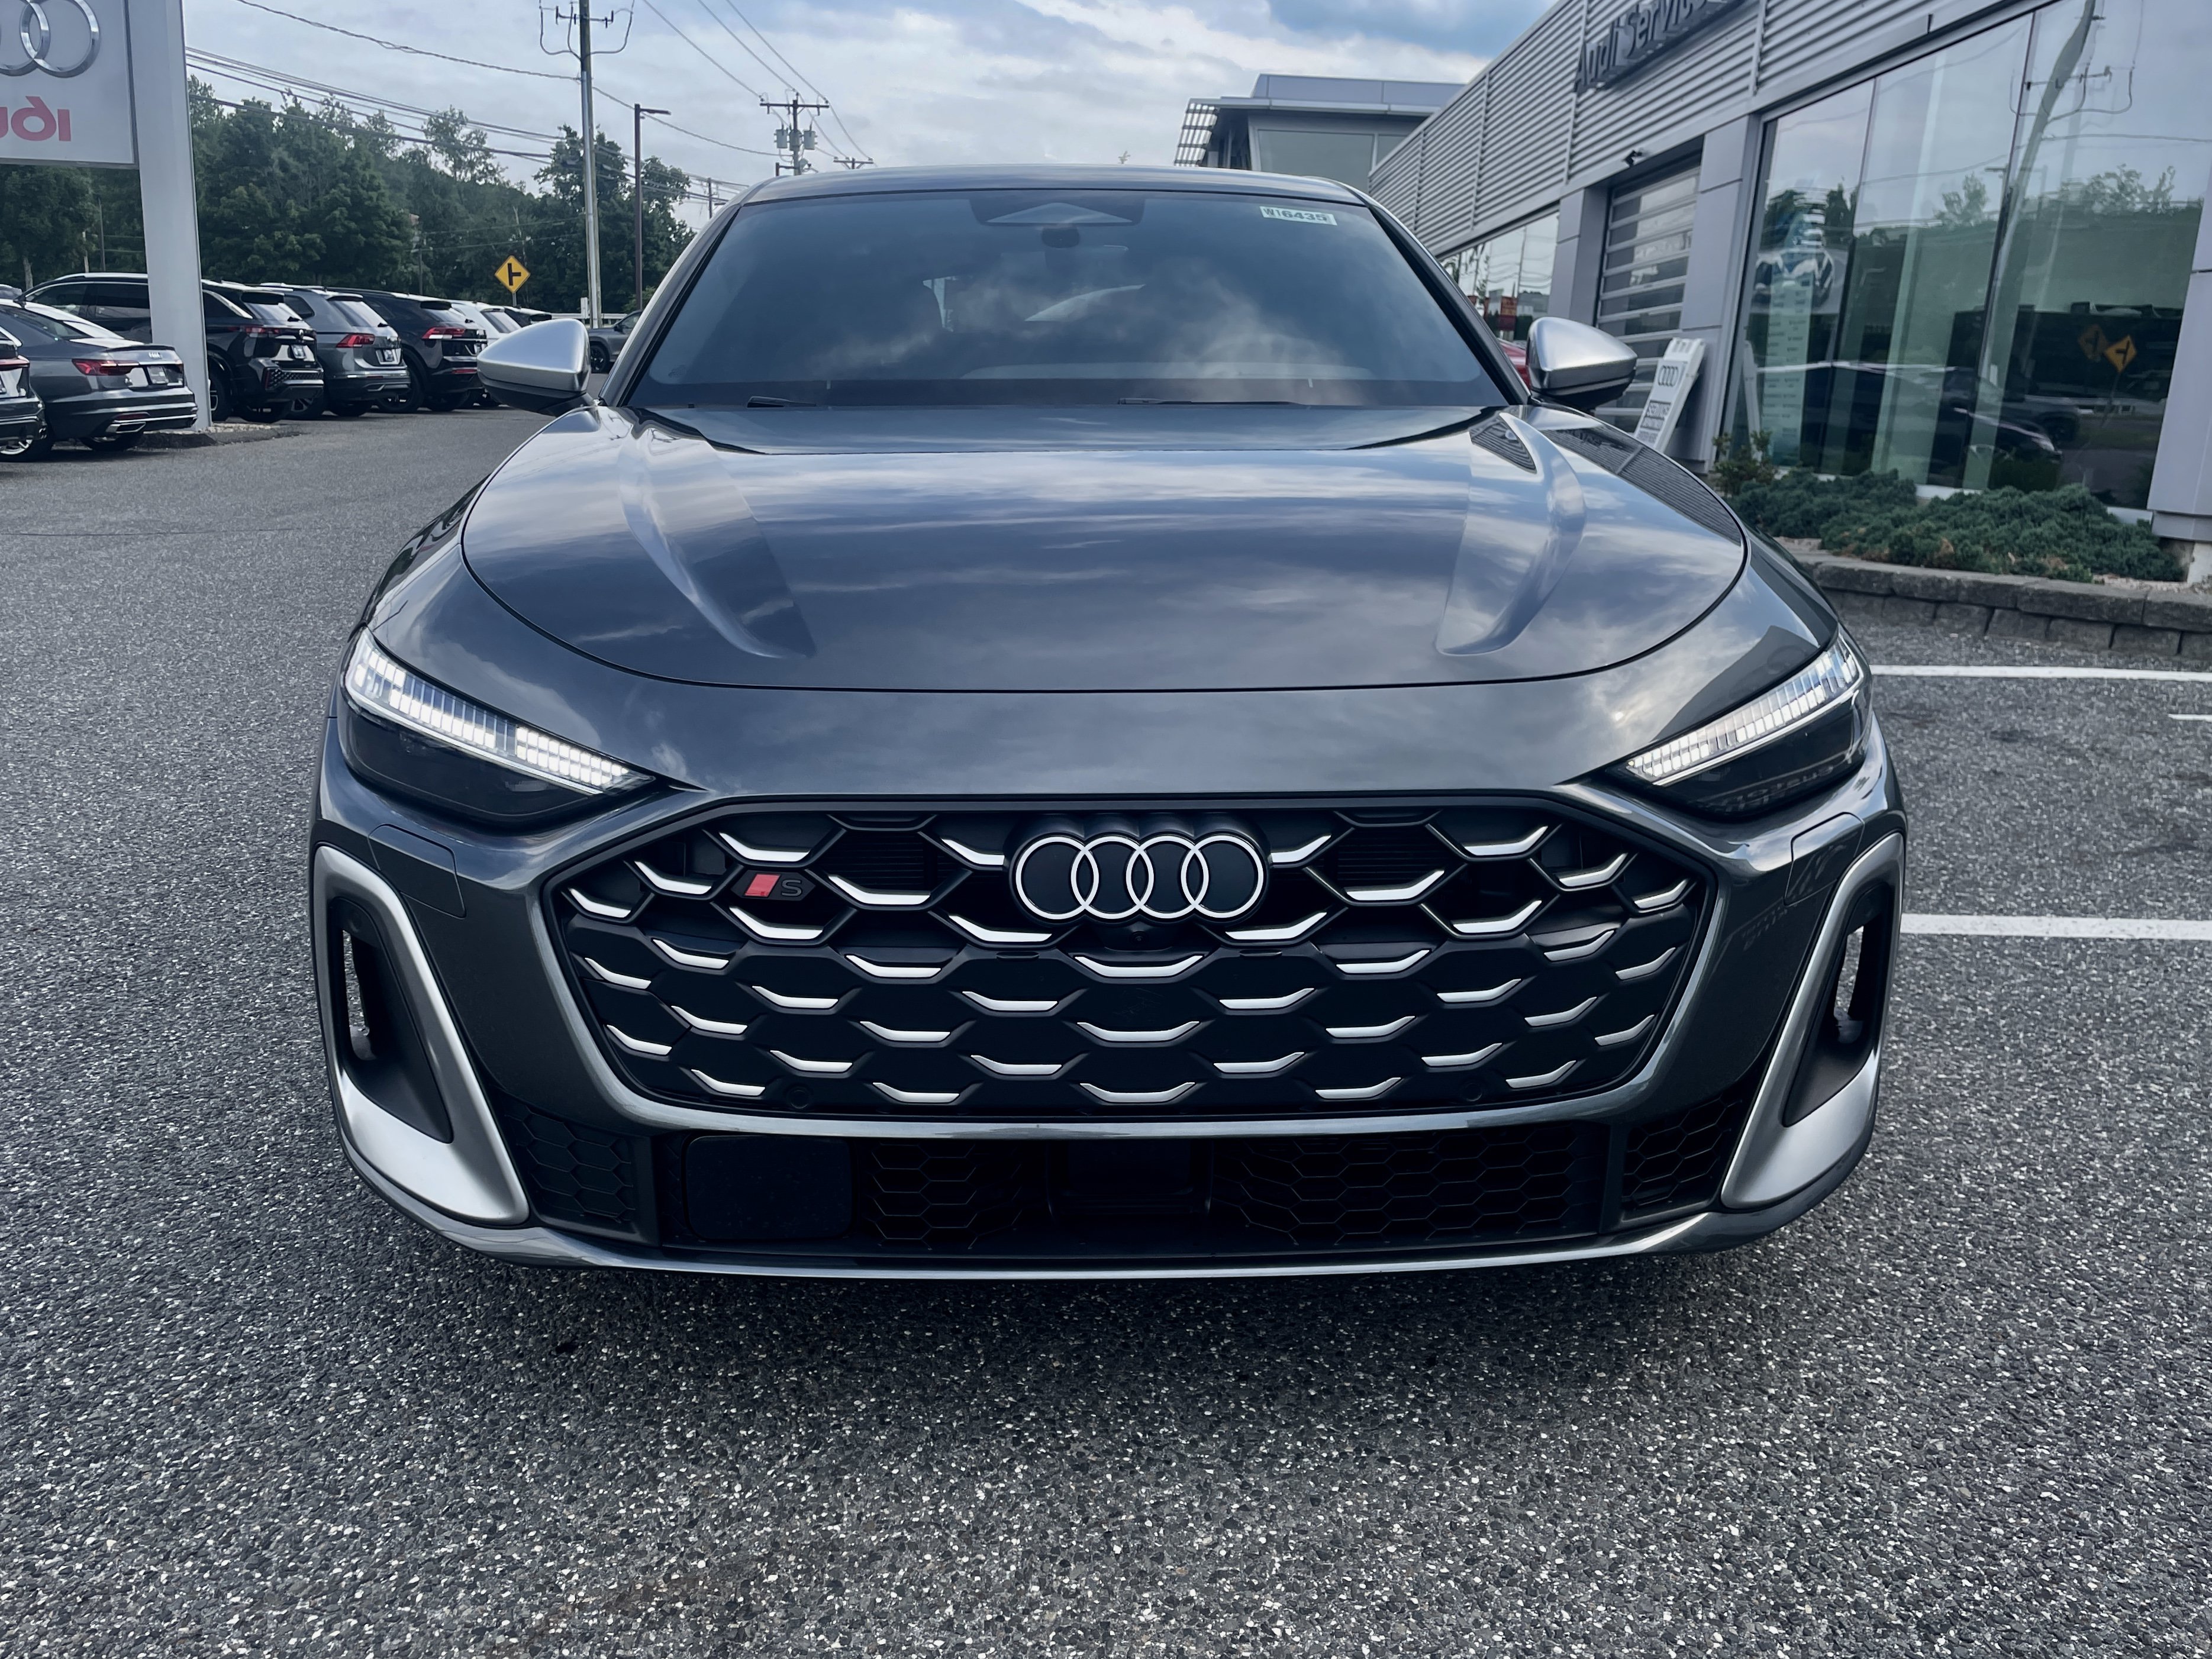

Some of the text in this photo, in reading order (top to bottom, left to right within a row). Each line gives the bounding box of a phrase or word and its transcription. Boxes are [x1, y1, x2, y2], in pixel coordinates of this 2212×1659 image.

[1573, 0, 1707, 93] Audi Servic
[1263, 208, 1327, 221] W16435
[781, 879, 802, 896] S
